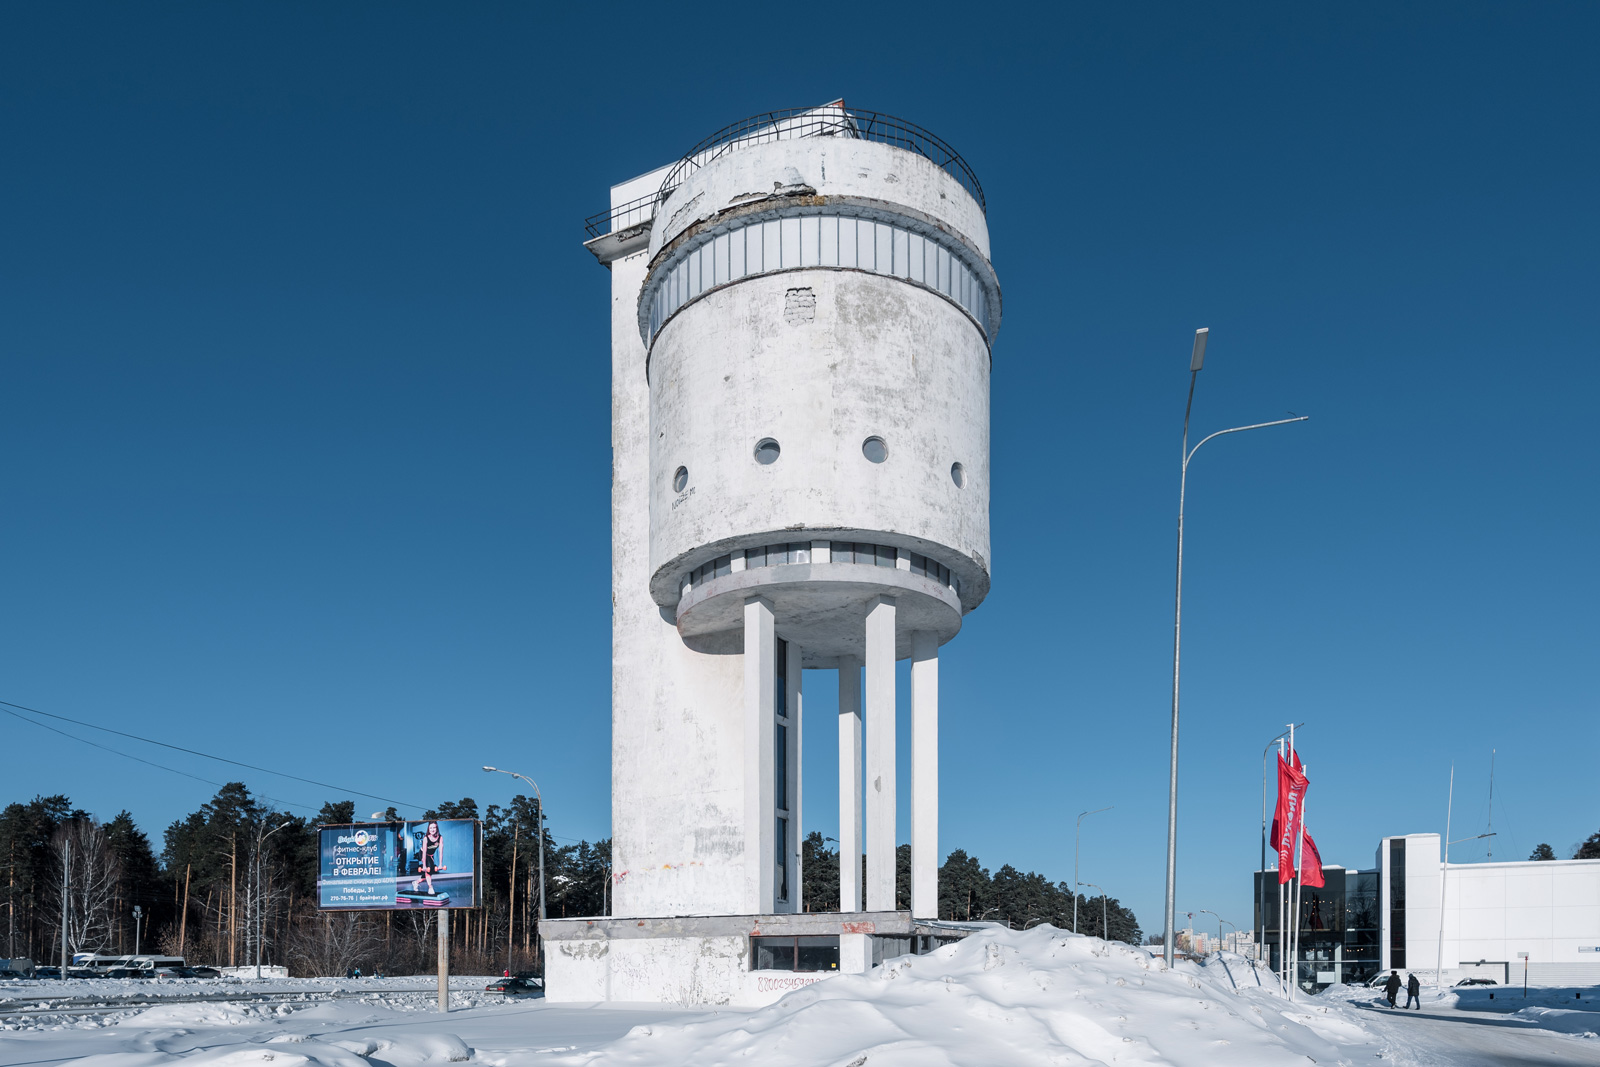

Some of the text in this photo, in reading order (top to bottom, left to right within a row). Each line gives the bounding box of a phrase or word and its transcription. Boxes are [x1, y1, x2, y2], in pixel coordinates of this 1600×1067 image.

[337, 845, 377, 854] фитнес-клуб
[336, 857, 379, 865] ОТКРЫТИЕ
[333, 867, 382, 876] В ФЕВРАЛЕ!
